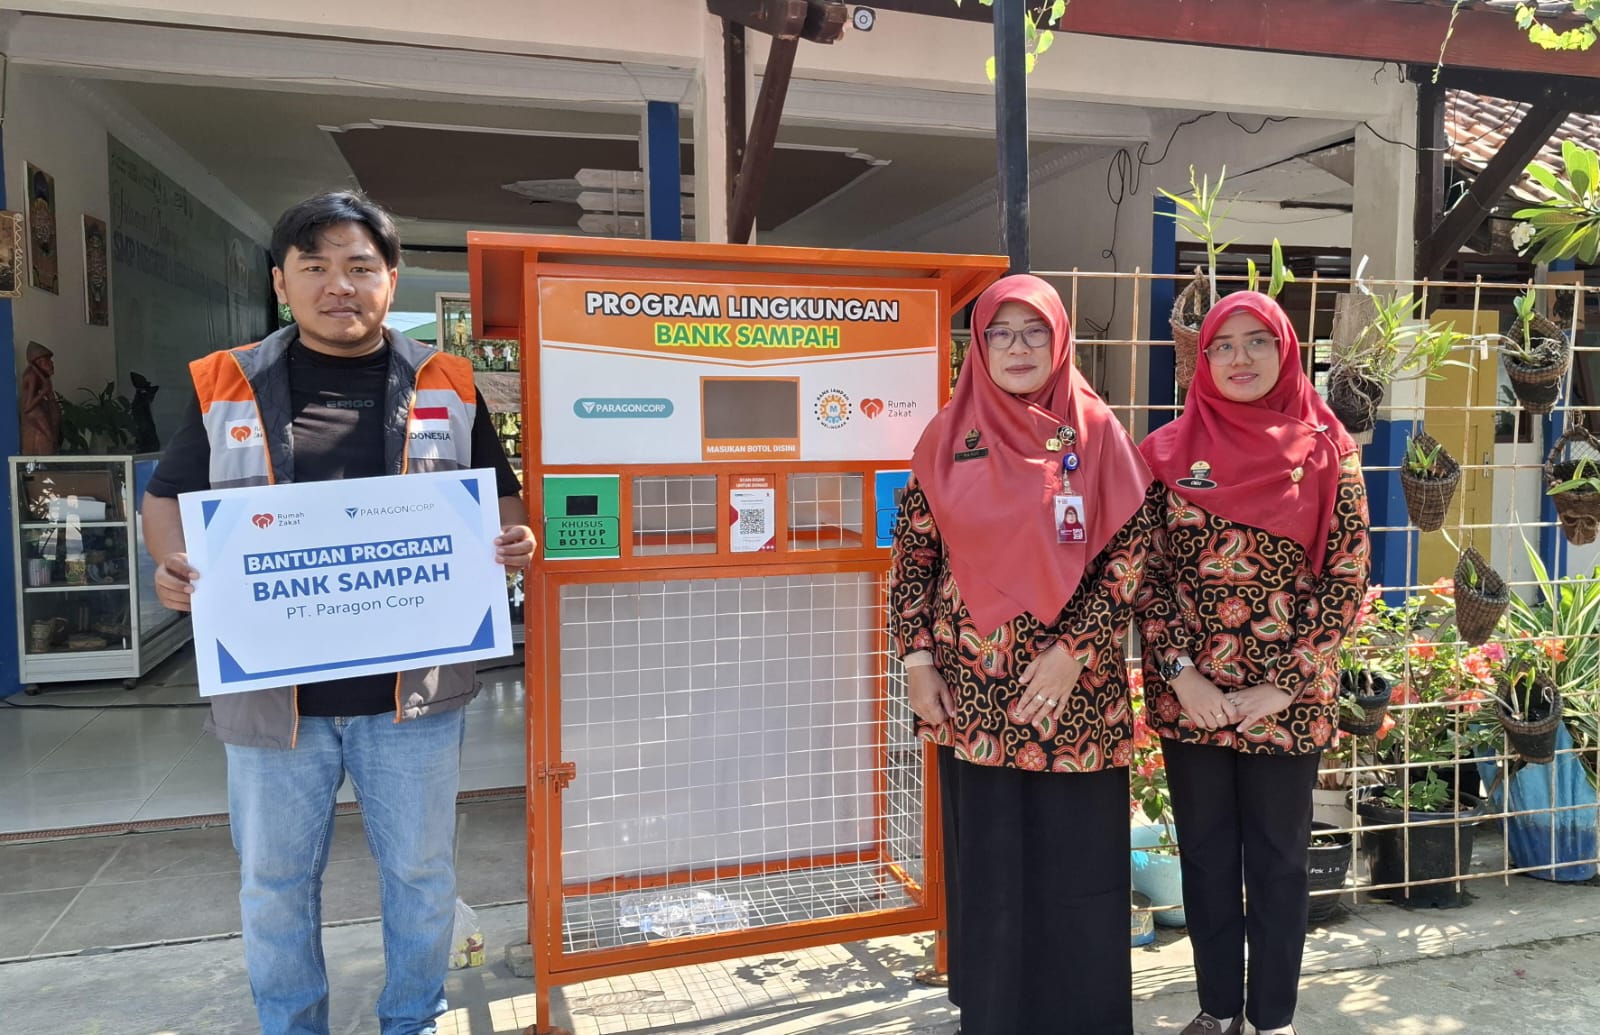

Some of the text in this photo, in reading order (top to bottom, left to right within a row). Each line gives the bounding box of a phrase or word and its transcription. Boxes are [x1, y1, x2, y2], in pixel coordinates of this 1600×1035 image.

[585, 291, 899, 321] PROGRAM LINGKUNGAN
[655, 322, 839, 348] BANK SAMPAH
[326, 399, 375, 408] ERIGO
[596, 404, 666, 413] PARAGONCORP
[408, 432, 450, 441] DONESIA
[707, 445, 746, 453] MASUKAN
[748, 445, 772, 453] BOTOL
[360, 503, 435, 517] PARAGONCORP
[277, 512, 305, 520] Rumah
[278, 519, 301, 527] Zakat
[558, 529, 606, 537] TUTUP
[560, 538, 606, 546] BOTOL
[247, 537, 450, 572] BANTUAN PROGRAM
[253, 562, 450, 602] BANK SAMPAH
[286, 595, 425, 619] PT. Paragon Corp
